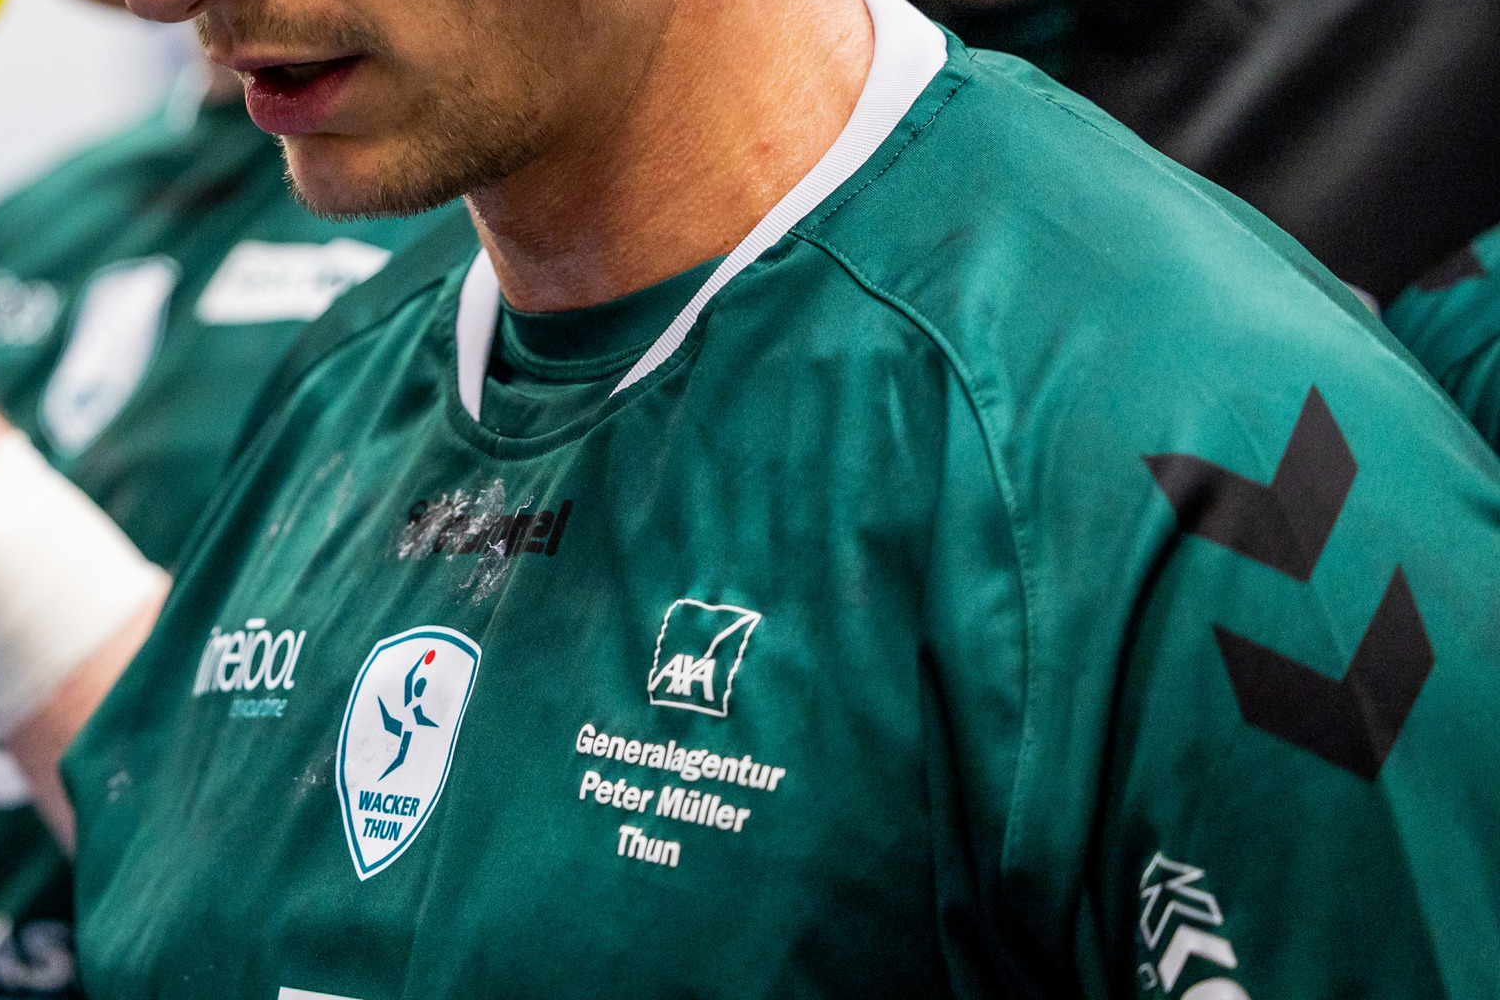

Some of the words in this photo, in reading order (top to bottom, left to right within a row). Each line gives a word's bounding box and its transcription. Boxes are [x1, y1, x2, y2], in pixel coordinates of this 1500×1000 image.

[647, 653, 717, 702] AXA
[575, 723, 787, 792] Generalagentur
[358, 790, 421, 818] WACKER
[578, 770, 655, 813] Peter
[655, 785, 751, 833] Müller
[362, 817, 403, 842] THUN
[617, 824, 681, 868] Thun
